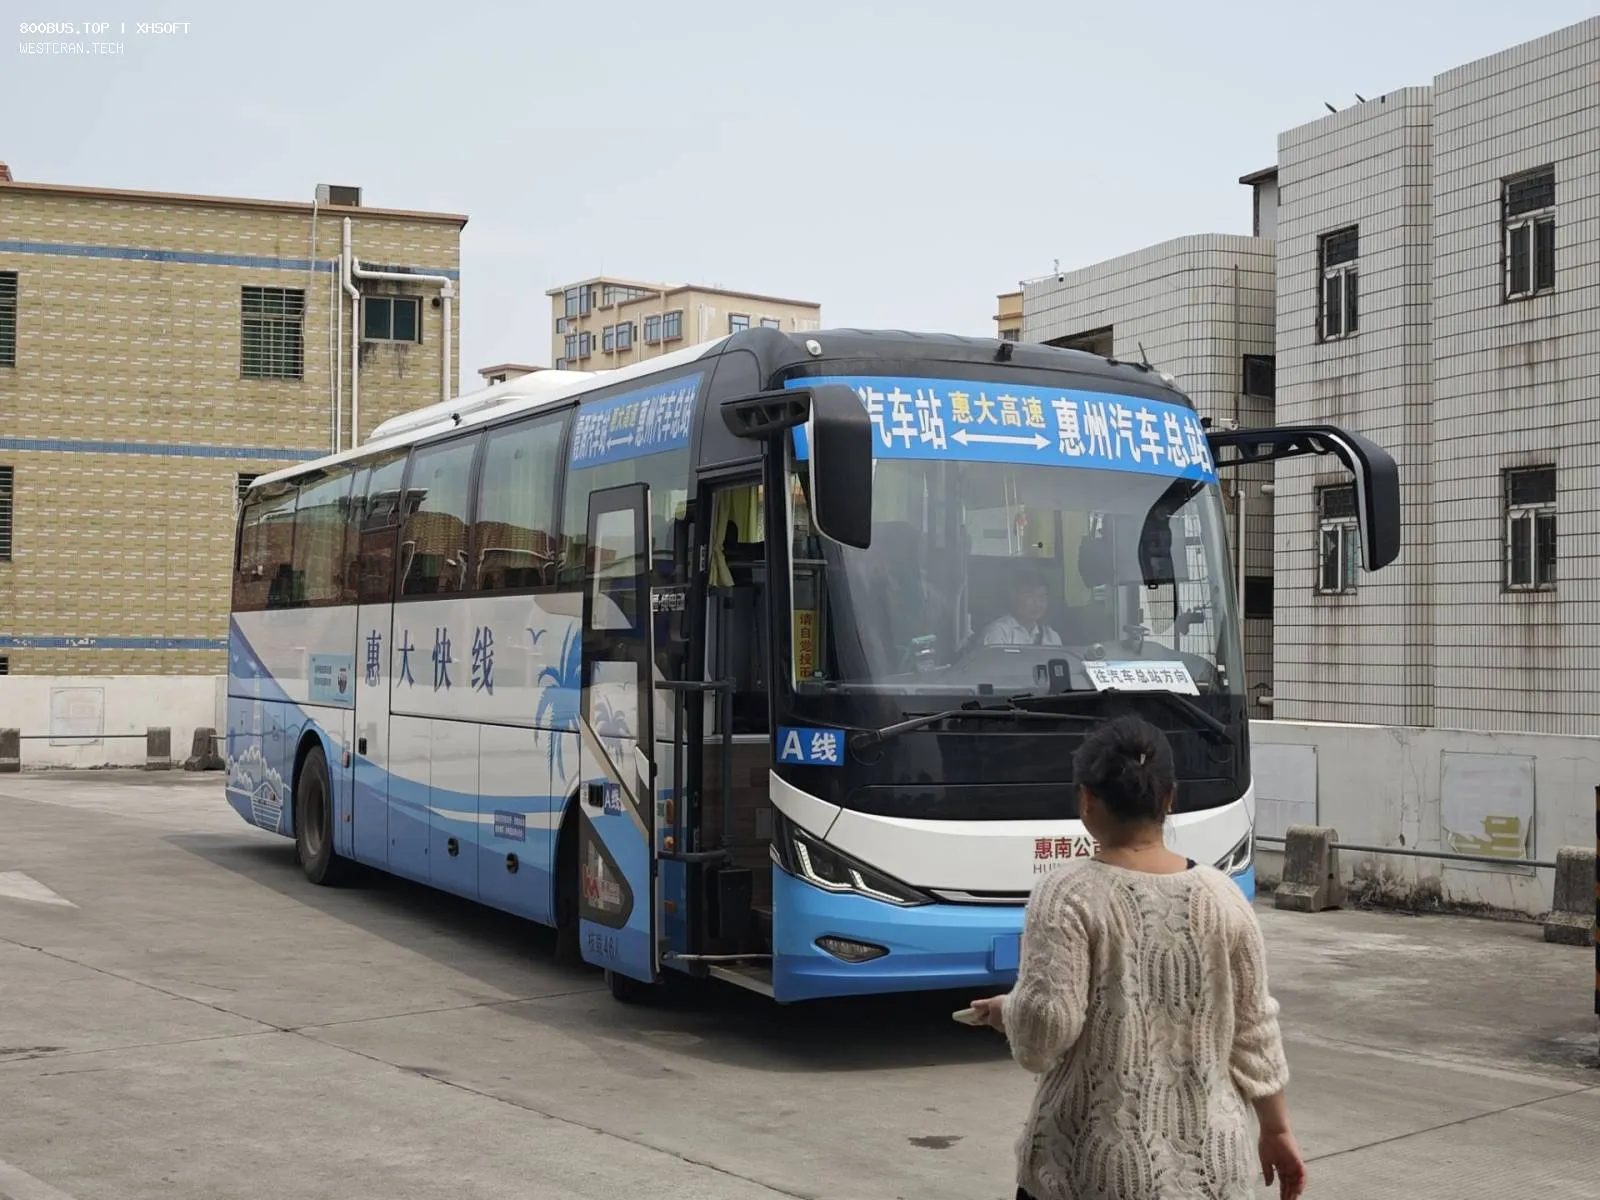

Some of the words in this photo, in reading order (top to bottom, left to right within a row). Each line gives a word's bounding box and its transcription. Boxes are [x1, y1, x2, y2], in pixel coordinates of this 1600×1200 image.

[947, 390, 1047, 429] 惠大高速
[1051, 396, 1213, 474] 惠州汽车总站
[364, 626, 495, 696] 惠大快线
